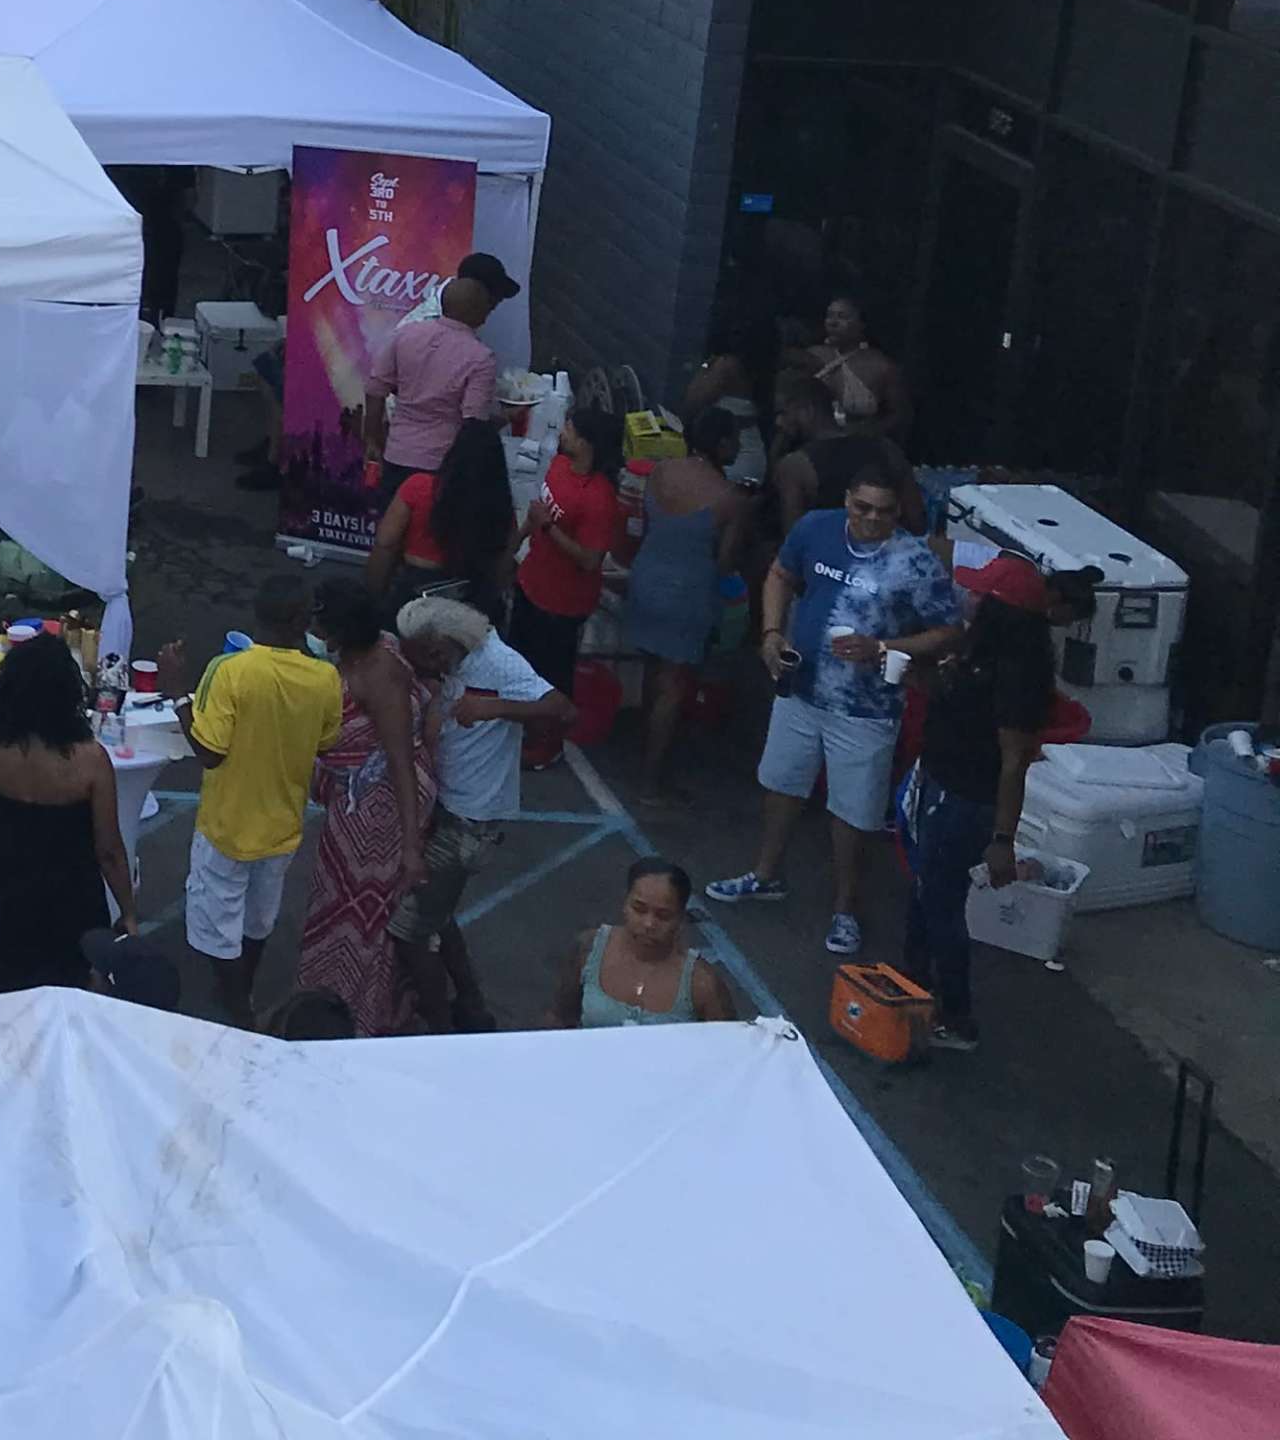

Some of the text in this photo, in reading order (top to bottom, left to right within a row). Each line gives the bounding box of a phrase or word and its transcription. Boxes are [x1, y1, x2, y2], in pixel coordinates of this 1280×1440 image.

[369, 209, 393, 222] 5TH
[311, 509, 320, 523] 3
[323, 511, 359, 530] DAYS
[814, 562, 844, 581] ONE
